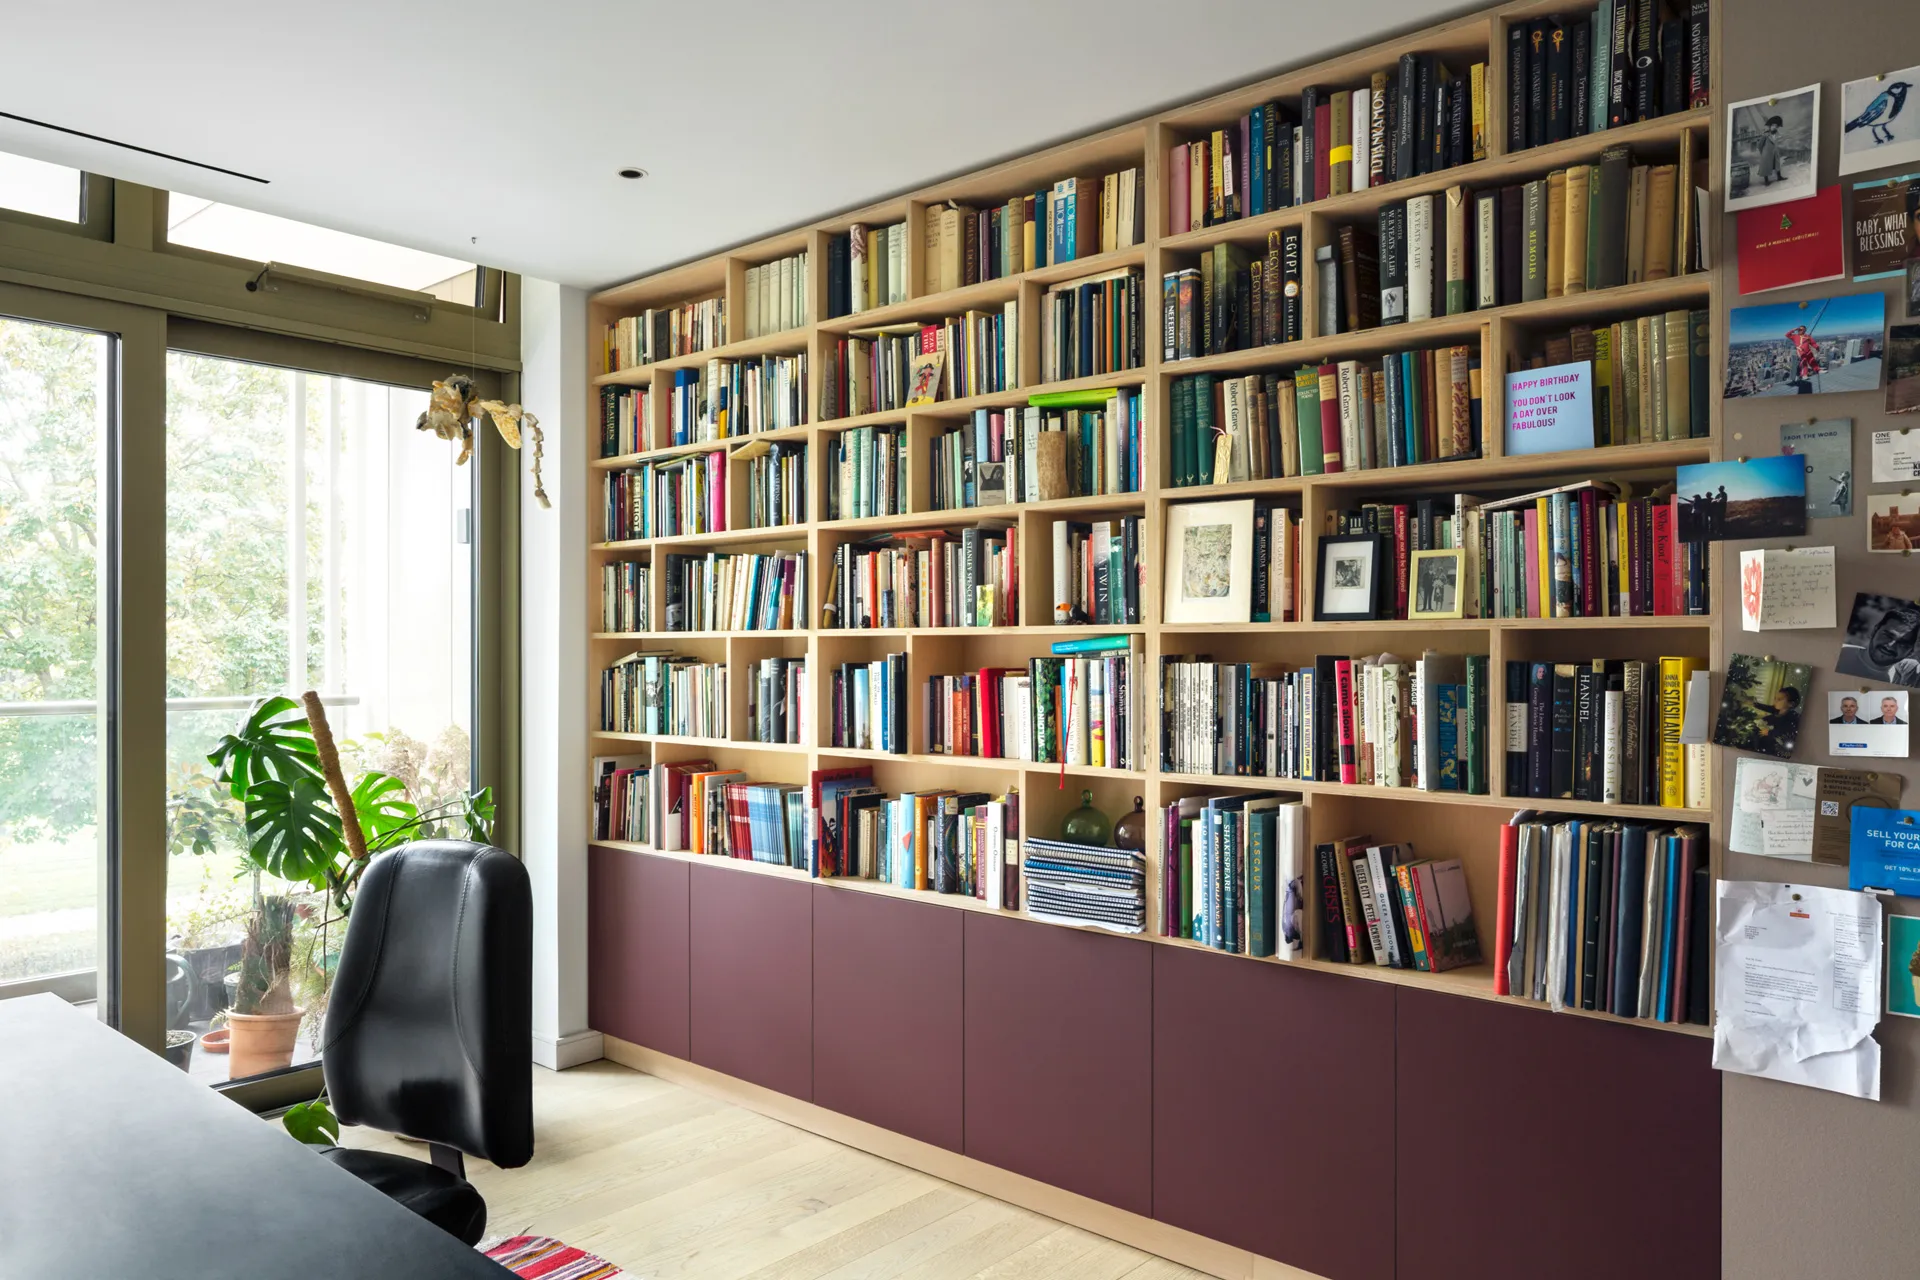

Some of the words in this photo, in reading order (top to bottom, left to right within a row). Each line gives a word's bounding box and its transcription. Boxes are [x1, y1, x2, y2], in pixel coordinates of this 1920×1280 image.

[1692, 2, 1708, 10] Nick
[1692, 22, 1701, 93] TUTANCHAMON
[1613, 70, 1622, 84] NICK
[1613, 85, 1622, 104] DRAKE
[1371, 90, 1385, 176] TUTANKAMON
[1856, 219, 1882, 236] BABY,
[1884, 212, 1908, 230] WHAT
[1860, 230, 1905, 252] BLESSINGS
[1270, 249, 1278, 285] EGYPT
[1286, 235, 1297, 274] EGYPT
[1529, 229, 1537, 280] MEMOIRS
[1230, 382, 1238, 406] Robert
[1341, 368, 1351, 397] Robert
[1512, 380, 1538, 391] HAPPY
[1540, 374, 1580, 386] BIRTHDAY
[1342, 394, 1352, 419] Graves
[1512, 398, 1528, 407] YOU
[1554, 391, 1576, 402] LOOK
[1512, 418, 1555, 431] FABULOUS!
[1519, 409, 1534, 418] DAY
[1536, 406, 1558, 416] OVER
[1657, 509, 1668, 532] Why
[1658, 535, 1669, 564] Knot?
[1099, 534, 1107, 603] CHATWIN
[1342, 677, 1350, 706] came
[1579, 674, 1590, 723] HANDEL
[1632, 668, 1640, 711] HANDEL'S
[1342, 709, 1351, 739] alone
[1509, 704, 1517, 750] HANDEL
[1664, 690, 1680, 743] STASILAND
[1606, 727, 1616, 784] MESSIAH
[1202, 825, 1208, 836] TO
[1867, 829, 1891, 839] SELL
[1894, 832, 1920, 841] YOUR
[1885, 840, 1904, 848] FOR
[1253, 832, 1261, 891] LASCAUX
[1320, 852, 1328, 877] GLOBAL
[1356, 864, 1365, 884] QUEER
[1324, 875, 1340, 923] CRISES
[1361, 886, 1371, 899] CITY
[1364, 903, 1376, 923] PETER
[1379, 893, 1388, 917] QUEER
[1385, 920, 1395, 951] LONDON
